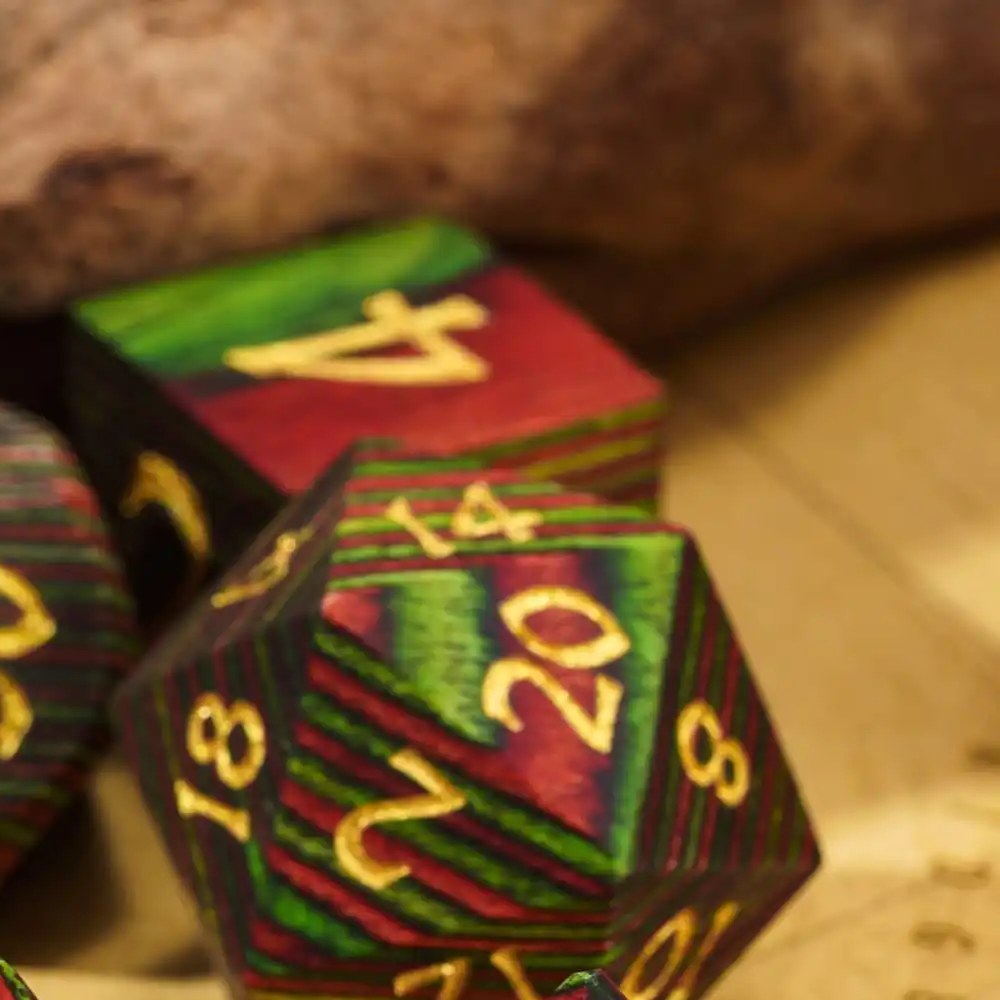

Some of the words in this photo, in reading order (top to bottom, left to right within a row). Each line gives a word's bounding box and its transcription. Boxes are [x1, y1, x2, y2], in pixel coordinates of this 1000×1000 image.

[223, 288, 492, 387] 4
[385, 481, 545, 559] 14
[481, 586, 632, 754] 20
[173, 692, 268, 843] 18
[675, 700, 750, 807] 8
